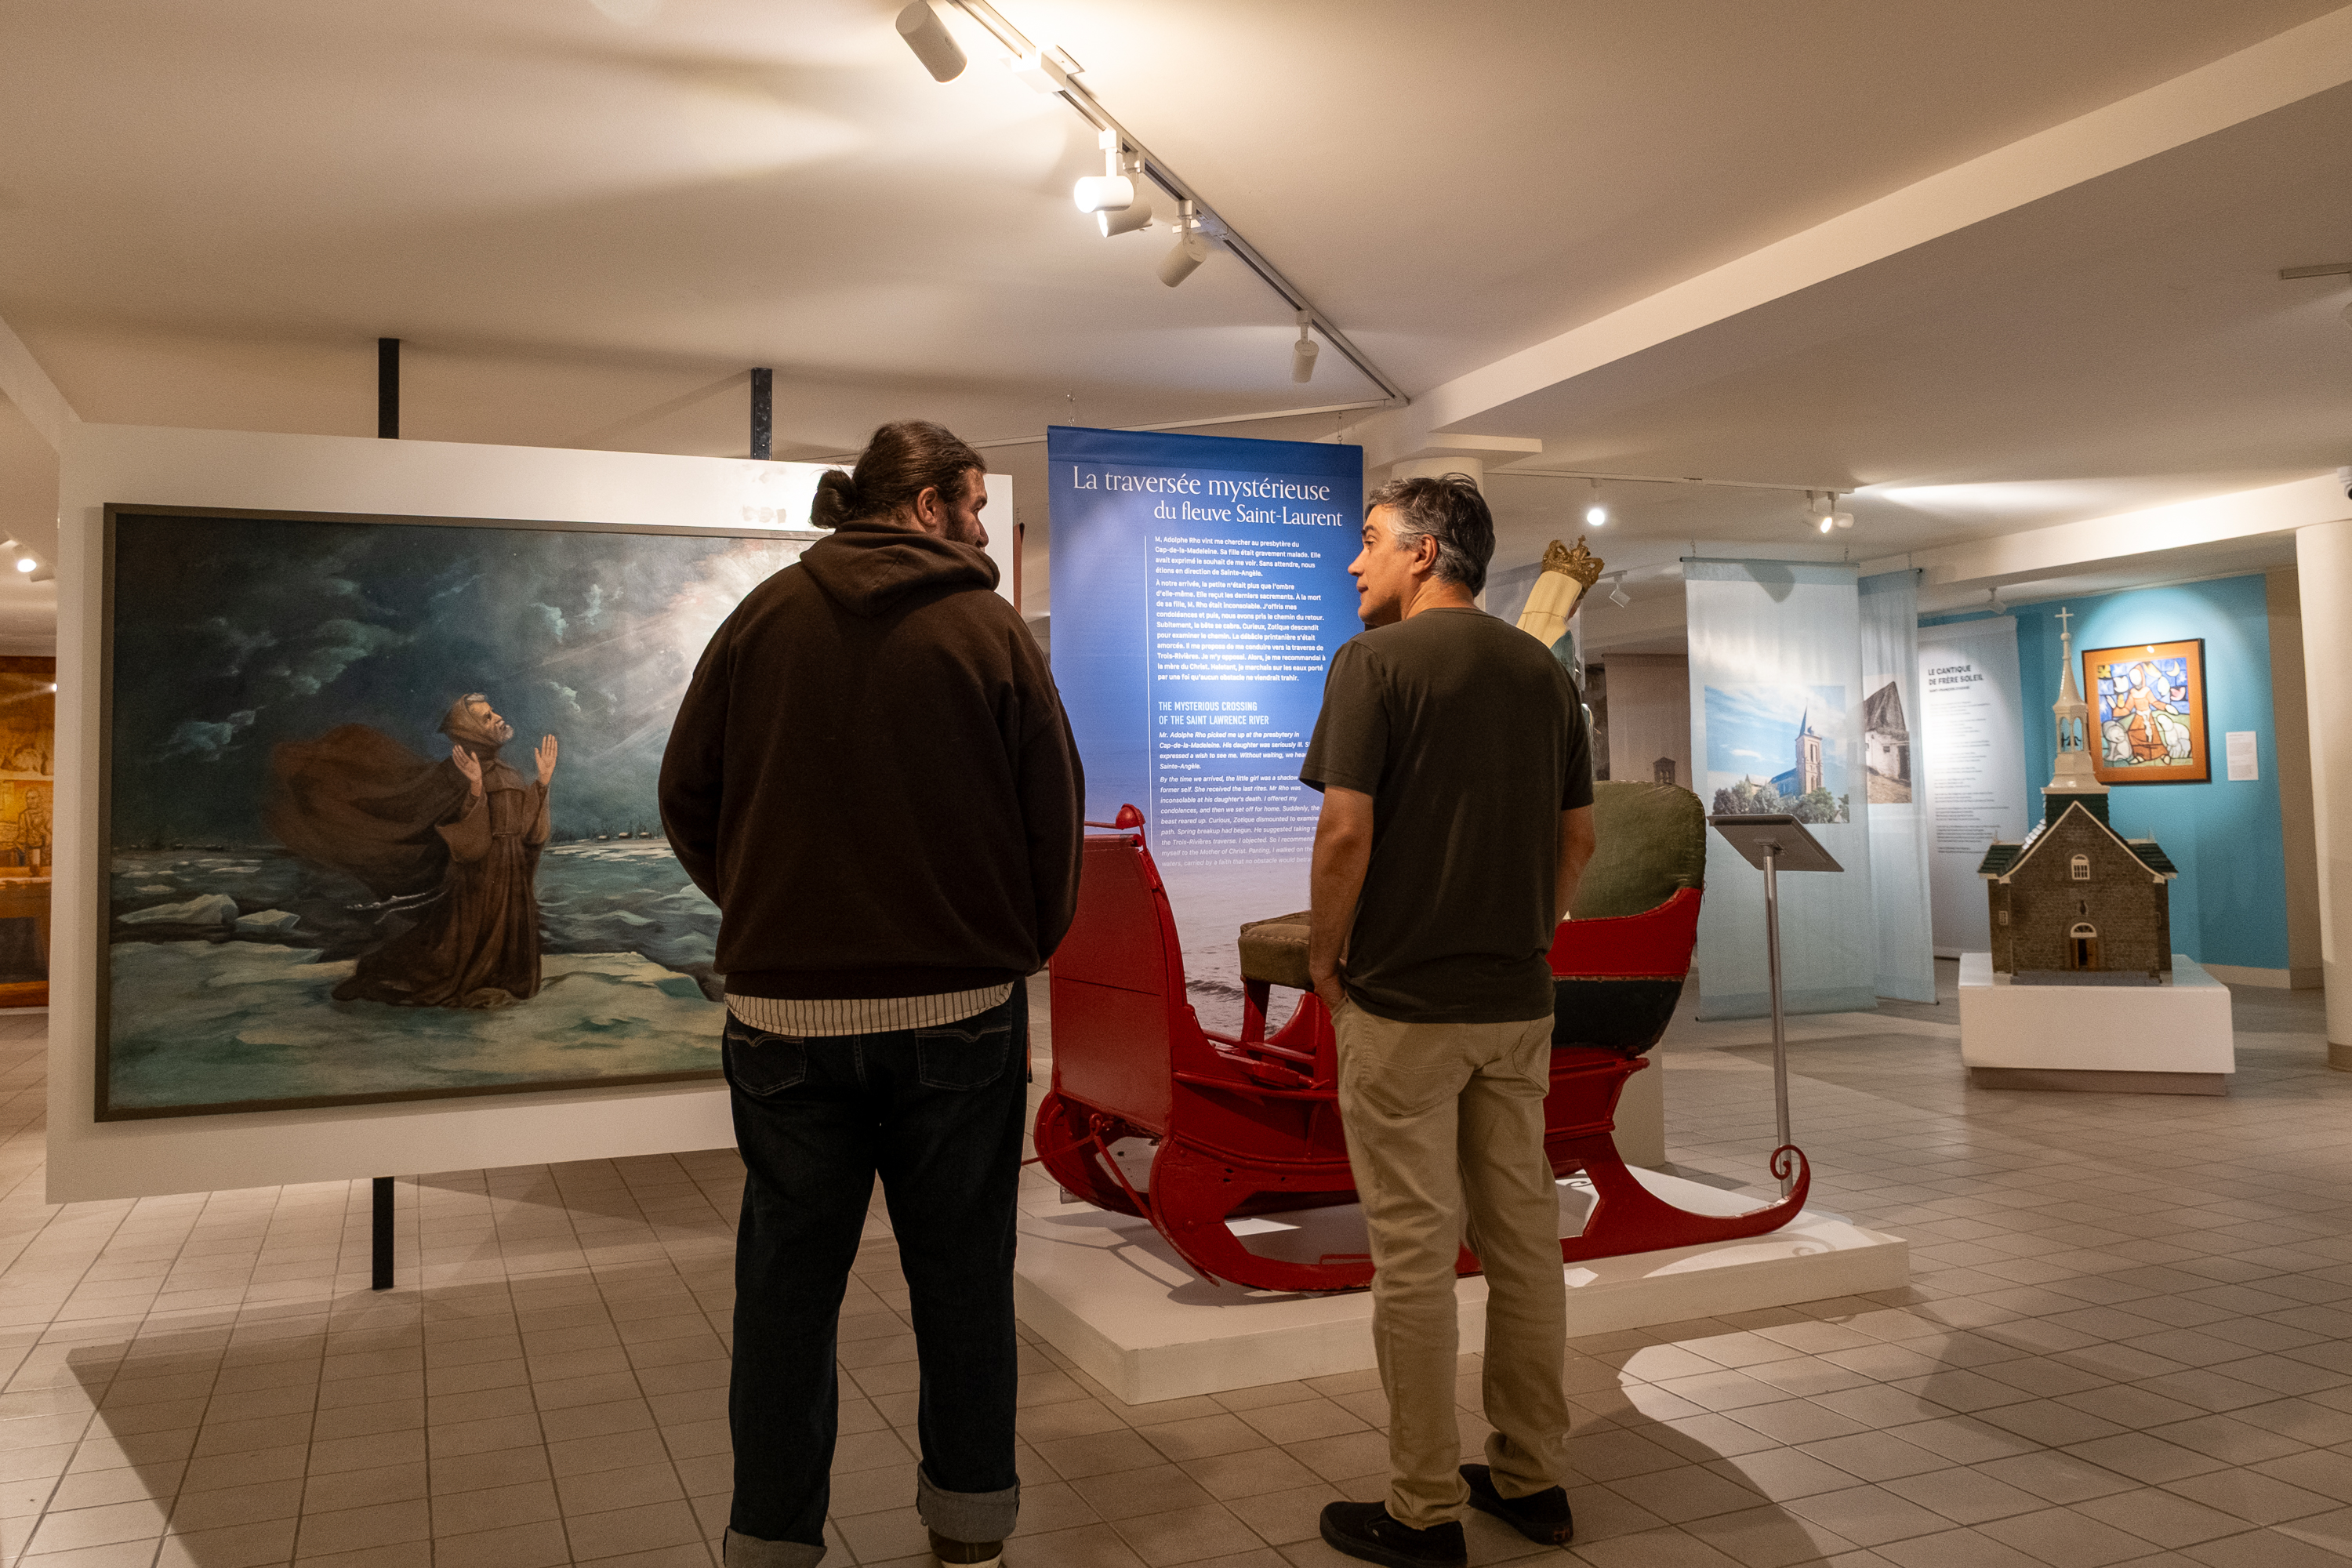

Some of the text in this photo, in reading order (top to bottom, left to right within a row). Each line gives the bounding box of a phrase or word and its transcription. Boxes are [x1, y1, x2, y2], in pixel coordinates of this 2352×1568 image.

[1073, 466, 1330, 503] La traversée mystérieuse
[1154, 500, 1343, 526] du fleuve Saint-Laurent
[1163, 535, 1188, 544] Adolphe
[1259, 539, 1290, 548] presbytère
[1155, 546, 1218, 555] Cap-de-la-Madeleine.
[1171, 557, 1196, 565] exprimé
[1274, 561, 1300, 569] attendre,
[1220, 568, 1262, 578] Sainte-Angèle.
[1156, 578, 1160, 586] À
[1178, 580, 1200, 589] arrivée,
[1208, 581, 1225, 590] petite
[1205, 612, 1220, 620] puis,
[1156, 621, 1192, 630] Subitement,
[1242, 622, 1266, 631] Curieux,
[1267, 623, 1290, 632] Zotique
[1936, 665, 1971, 674] CANTIQUE
[1939, 675, 1958, 684] FRÈRE
[1158, 701, 1257, 711] THE MYSTERIOUS CROSSING
[1158, 715, 1269, 725] OF THE SAINT LAWRENCE RIVER
[1263, 731, 1293, 739] presbytery
[1159, 742, 1221, 750] Cap-de-la-Madeleine.
[1232, 741, 1258, 750] daughter
[1271, 741, 1296, 750] seriously
[1159, 752, 1189, 760] expressed
[1262, 751, 1284, 760] waiting,
[1159, 762, 1201, 771] Sainte-Angèle.
[1160, 775, 1167, 784] By
